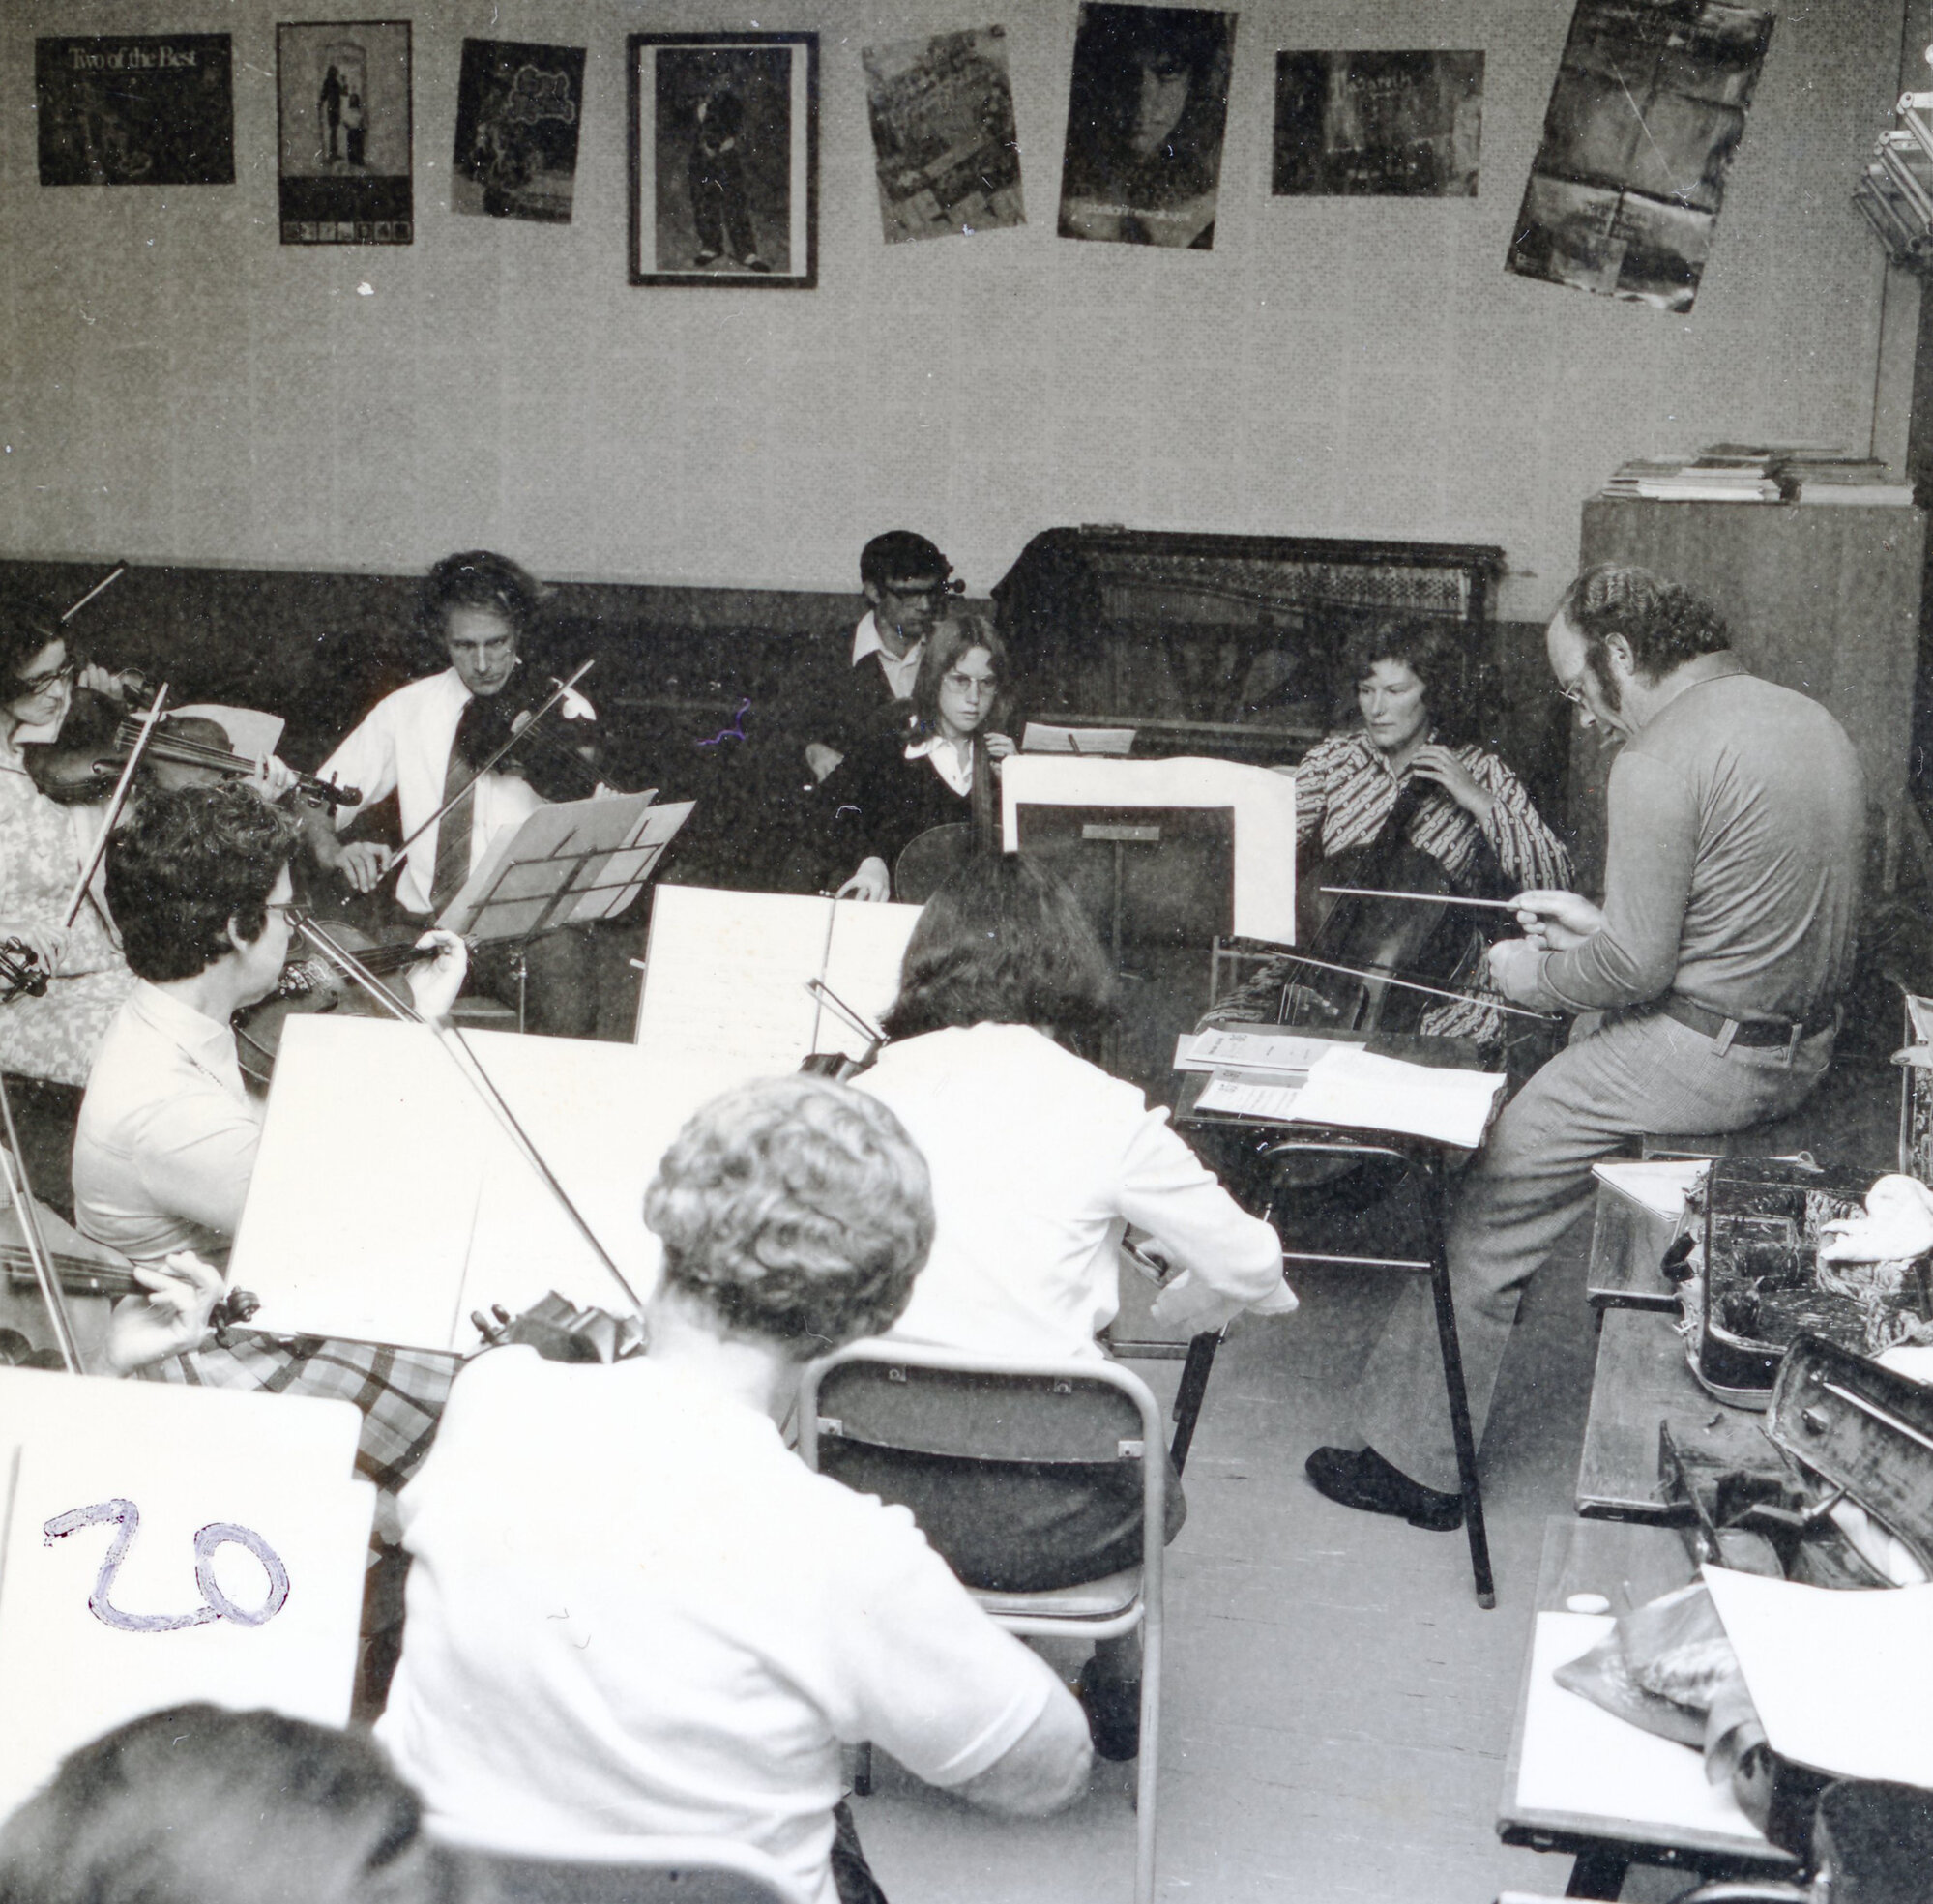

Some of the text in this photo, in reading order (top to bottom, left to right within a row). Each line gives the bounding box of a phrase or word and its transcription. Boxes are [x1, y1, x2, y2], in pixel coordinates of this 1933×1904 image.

[68, 45, 197, 70] Two of the Best
[43, 1497, 291, 1633] 20
